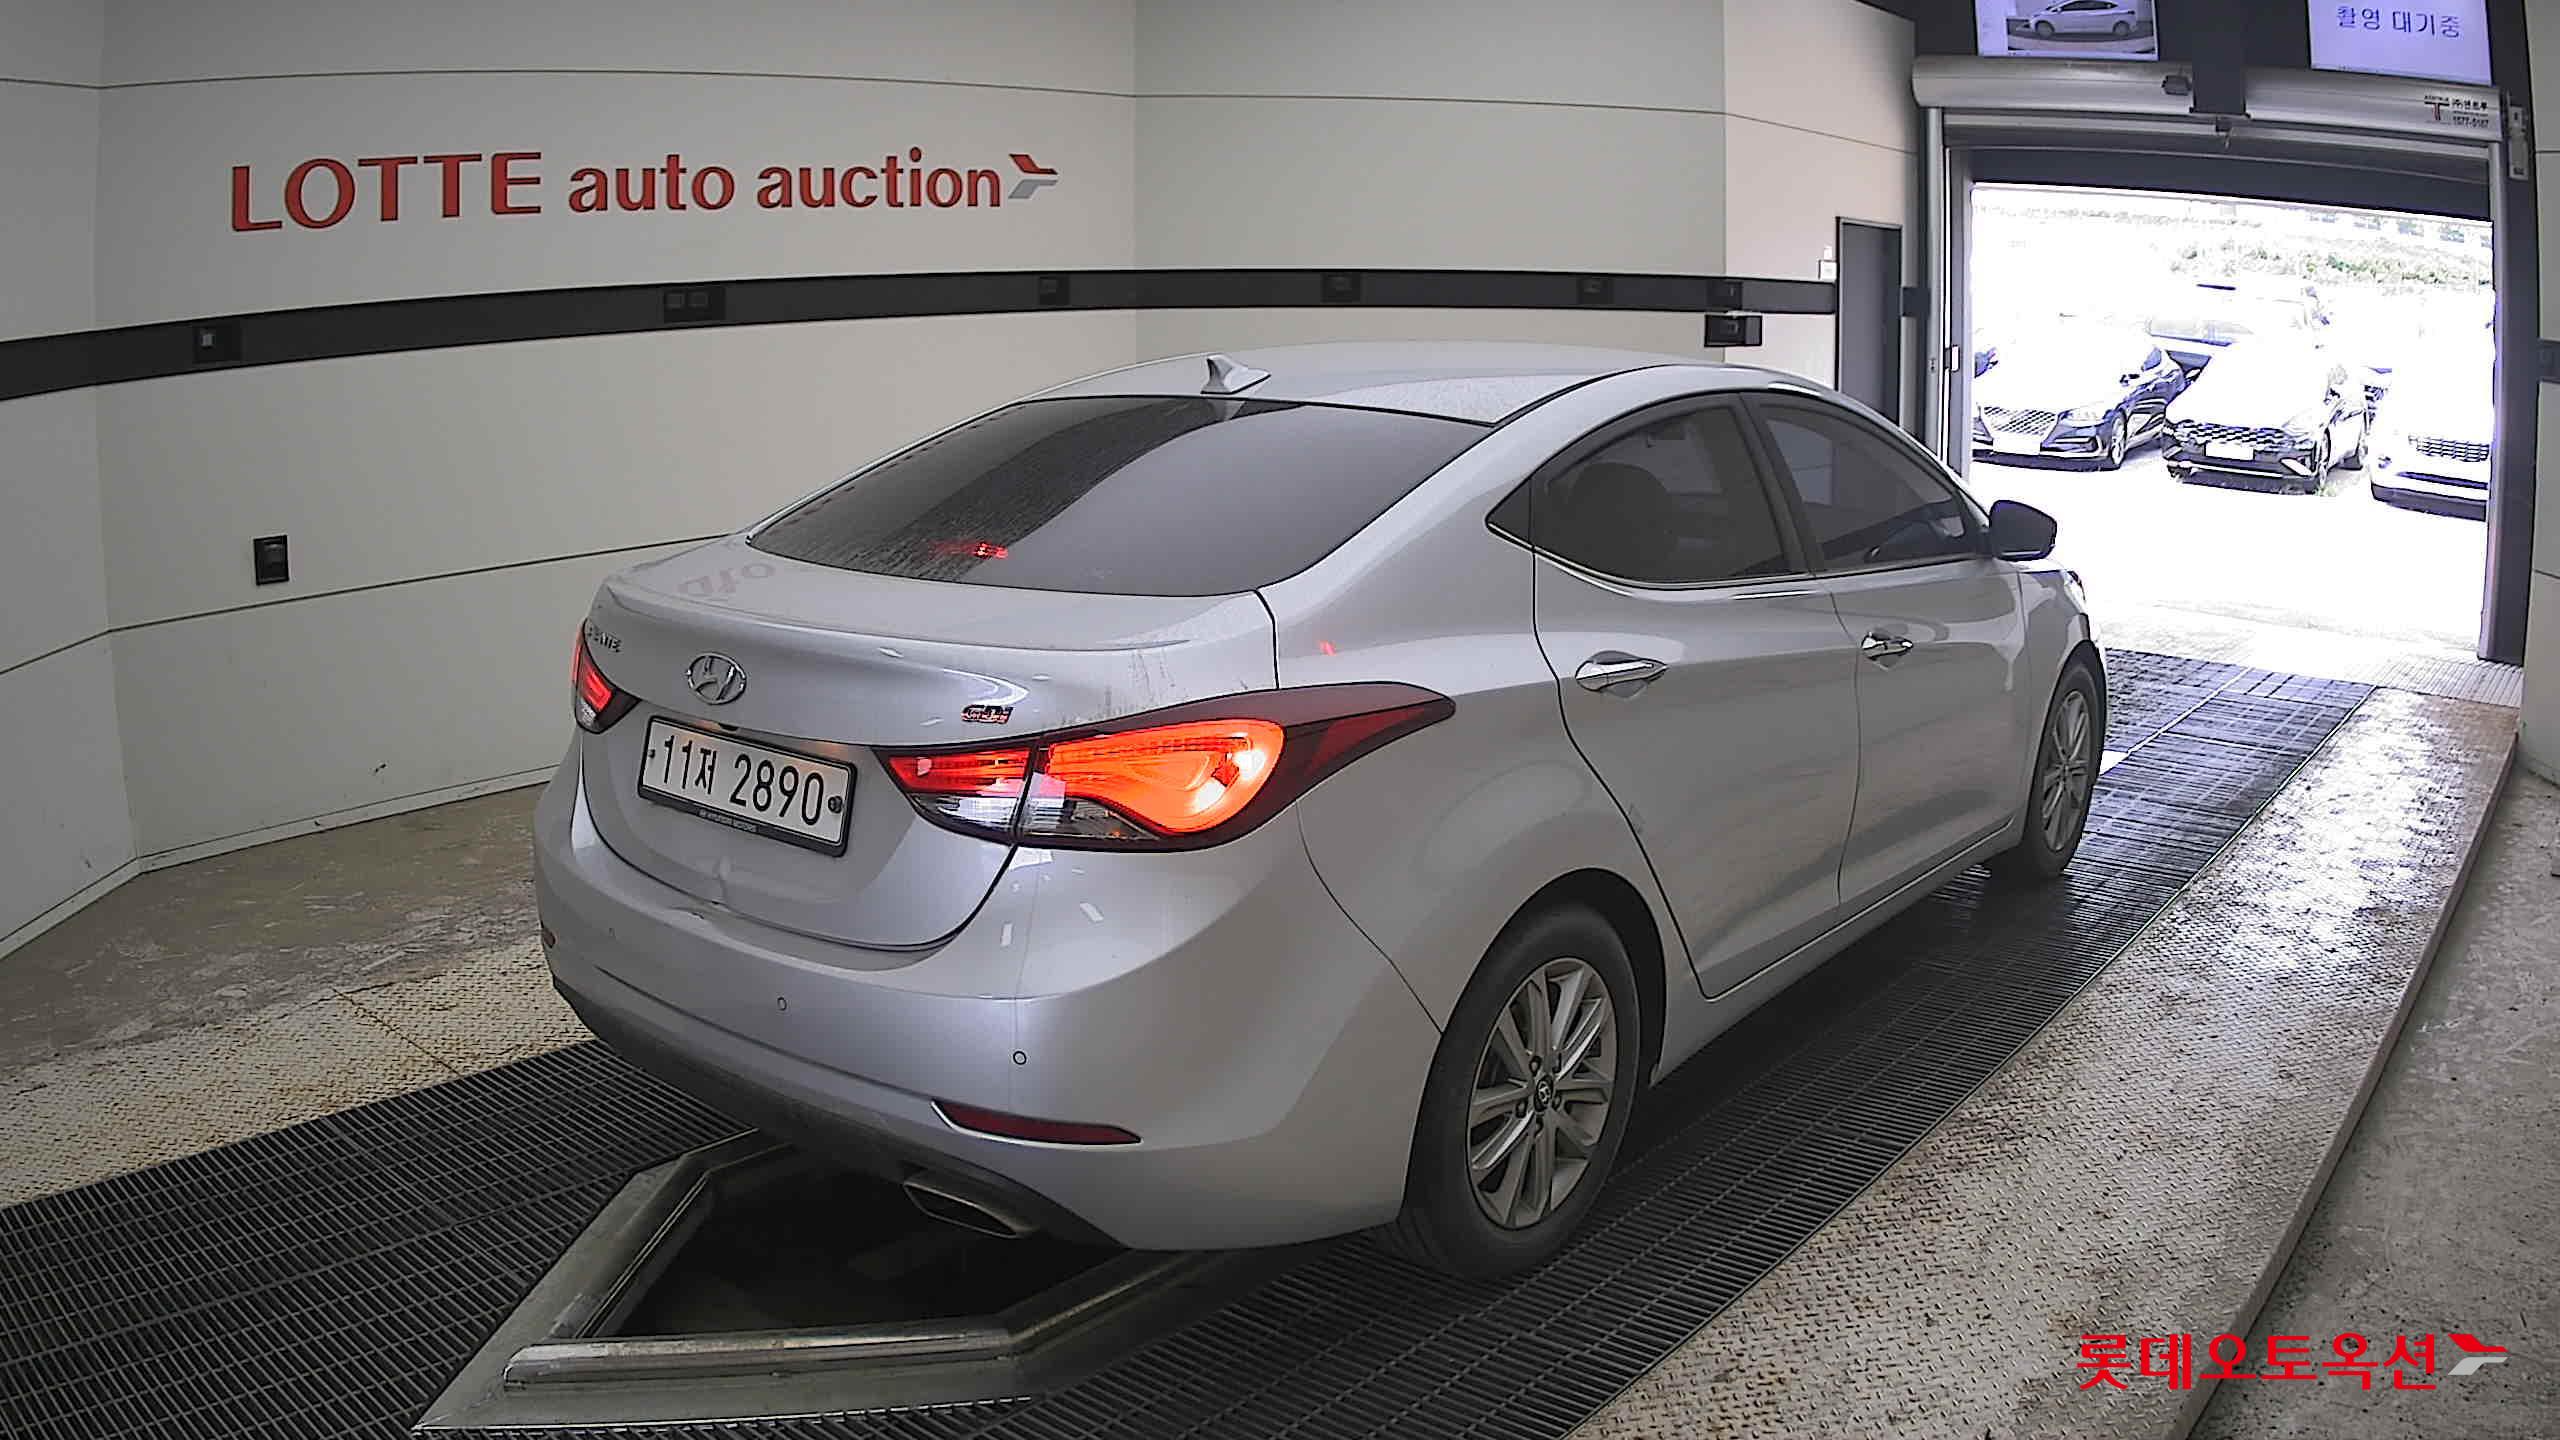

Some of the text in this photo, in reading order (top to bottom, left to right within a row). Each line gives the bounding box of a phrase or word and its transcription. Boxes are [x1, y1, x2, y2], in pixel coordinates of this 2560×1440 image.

[2337, 6, 2461, 39] 촬영 대기중
[232, 146, 1001, 232] LOTTE auto auction
[662, 734, 825, 826] 11저 2890
